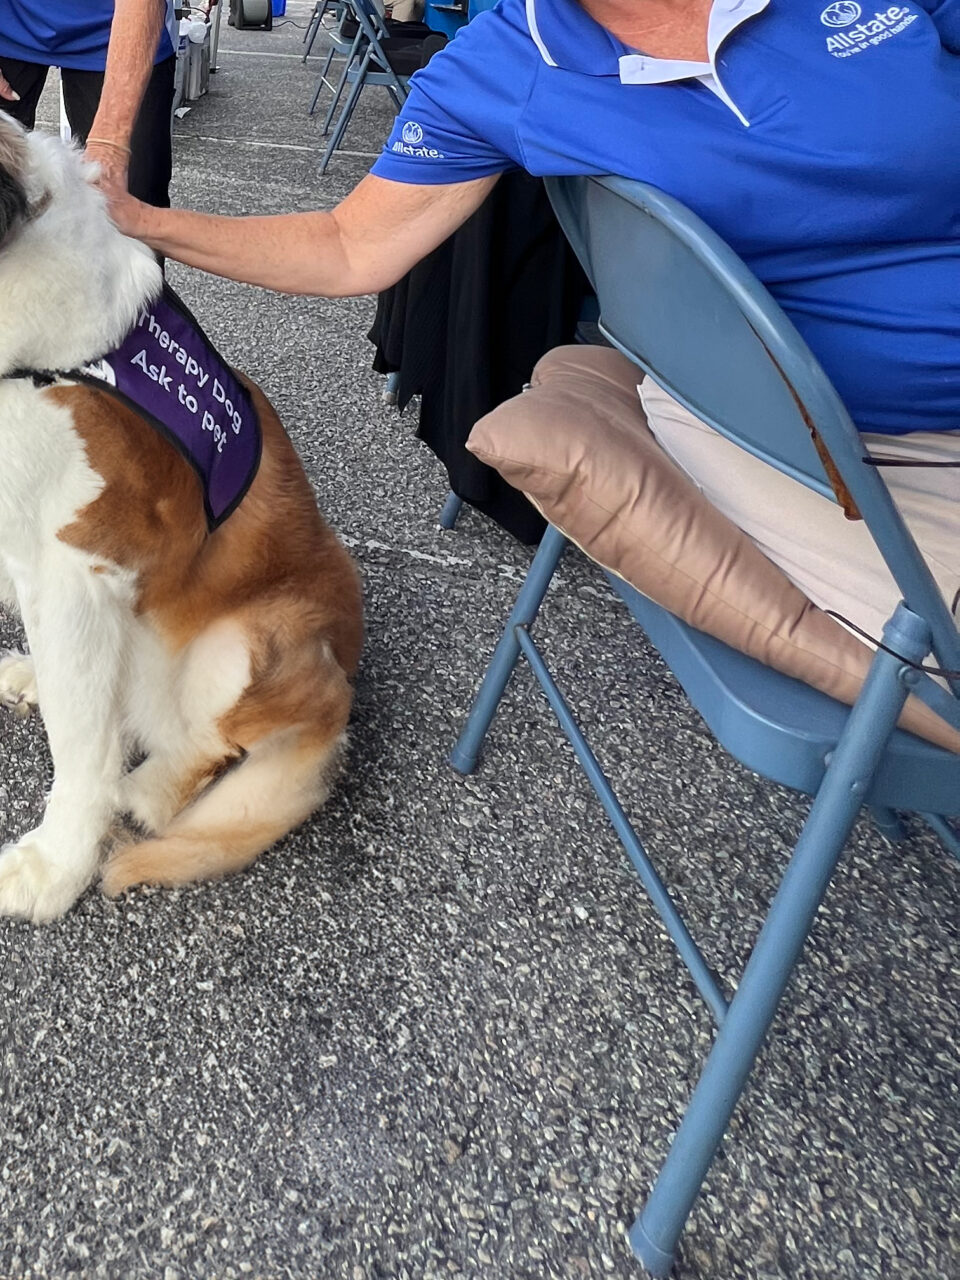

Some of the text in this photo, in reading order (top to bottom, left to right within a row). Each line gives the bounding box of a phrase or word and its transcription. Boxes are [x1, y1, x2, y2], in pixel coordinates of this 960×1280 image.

[130, 349, 228, 453] Ask to pet
[138, 310, 242, 435] Therapy Dog
